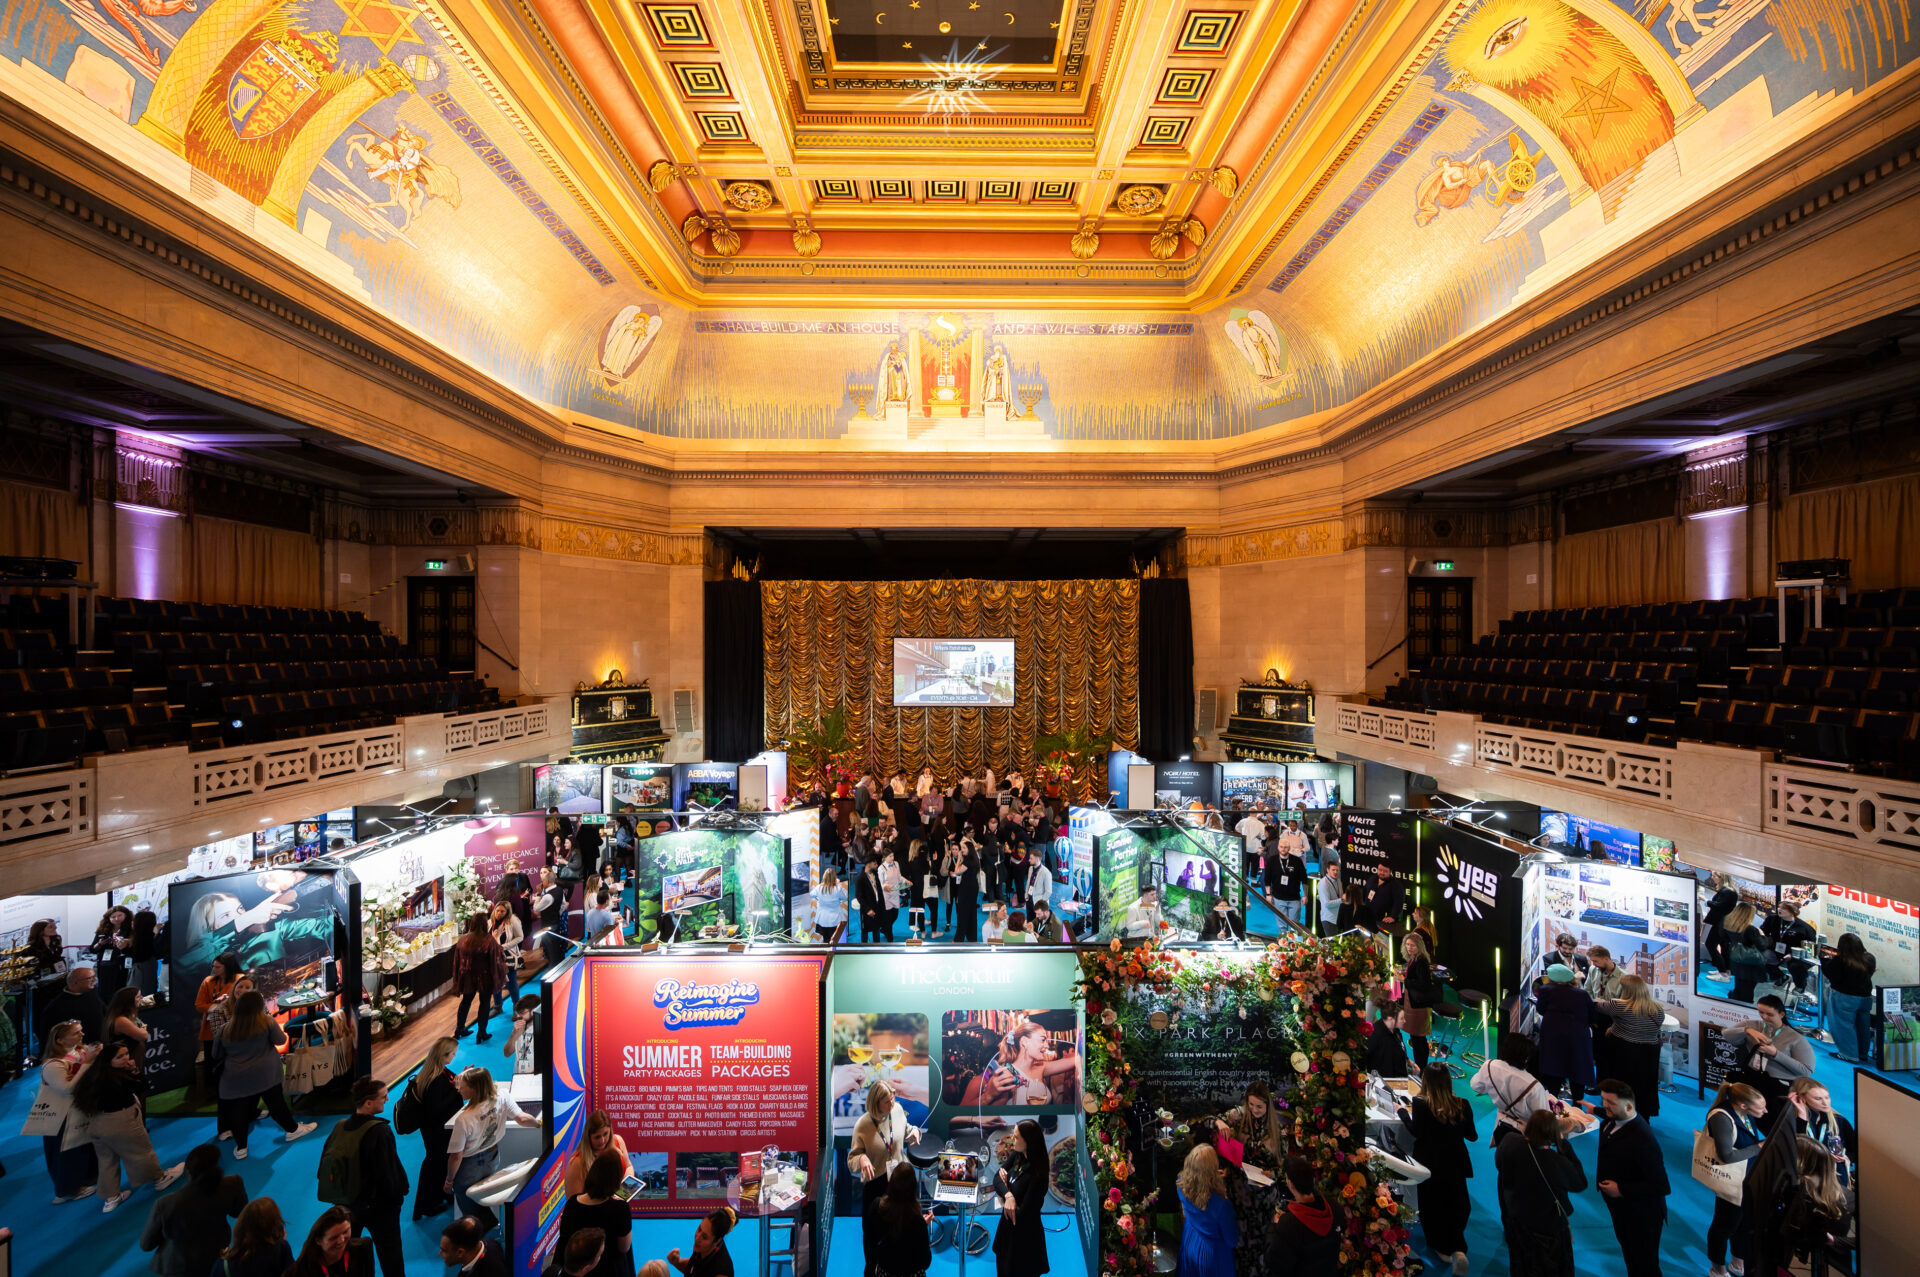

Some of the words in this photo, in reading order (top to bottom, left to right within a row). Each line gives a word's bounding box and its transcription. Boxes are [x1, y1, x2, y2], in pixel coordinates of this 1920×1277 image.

[1304, 234, 1330, 256] FOR
[1322, 206, 1354, 234] EVER
[1360, 162, 1399, 192] WILL
[1392, 136, 1420, 157] BE
[1414, 102, 1450, 131] HIS
[427, 91, 458, 114] BE
[451, 116, 542, 206] ESTABLISHED
[535, 207, 566, 232] FOR
[559, 232, 615, 286] EVERMORE
[718, 322, 760, 333] SHALL
[762, 322, 800, 333] BUILD
[801, 322, 825, 333] ME
[827, 322, 848, 333] AN
[850, 323, 899, 334] HOUSE
[993, 323, 1026, 334] AND
[1032, 323, 1038, 334] I
[1046, 323, 1081, 334] WILL
[1087, 324, 1159, 334] STABLISH
[1167, 324, 1192, 334] HIS
[688, 769, 708, 778] ABBA
[709, 770, 735, 779] Voyage
[1223, 779, 1267, 791] DREAMLAND
[1347, 815, 1376, 826] WRITE
[1347, 825, 1374, 837] Your
[1106, 836, 1133, 851] Summer
[1347, 834, 1379, 848] Event
[473, 853, 501, 866] CONIC
[502, 848, 540, 861] ELEGANCE
[1114, 846, 1138, 862] Parties
[1347, 843, 1389, 859] Stories.
[1346, 862, 1414, 881] MEMOBLE
[480, 874, 504, 884] OVENT
[1457, 860, 1498, 897] yes
[1827, 909, 1867, 924] ENTERTAINMENT
[1868, 921, 1904, 935] DESTINATION
[1876, 915, 1902, 929] ULTIMATE
[653, 977, 759, 1005] Reimagine
[933, 986, 974, 995] LONDON
[664, 1001, 745, 1029] Summer
[1711, 1007, 1741, 1018] Awards
[1125, 1027, 1145, 1039] IX
[1160, 1027, 1211, 1039] PARK
[1225, 1027, 1290, 1039] PLACE
[623, 1046, 702, 1068] SUMMER
[710, 1045, 792, 1059] TEAM-BUILDING
[311, 1062, 329, 1070] AYS
[711, 1064, 791, 1077] PACKAGES
[623, 1069, 652, 1078] PARTY
[654, 1069, 702, 1078] PACKAGES
[1147, 1069, 1193, 1078] quintessential
[1194, 1069, 1217, 1078] English
[1219, 1069, 1245, 1078] country
[1246, 1070, 1269, 1078] garden
[1162, 1080, 1198, 1088] panoramic
[1200, 1079, 1218, 1088] Royal
